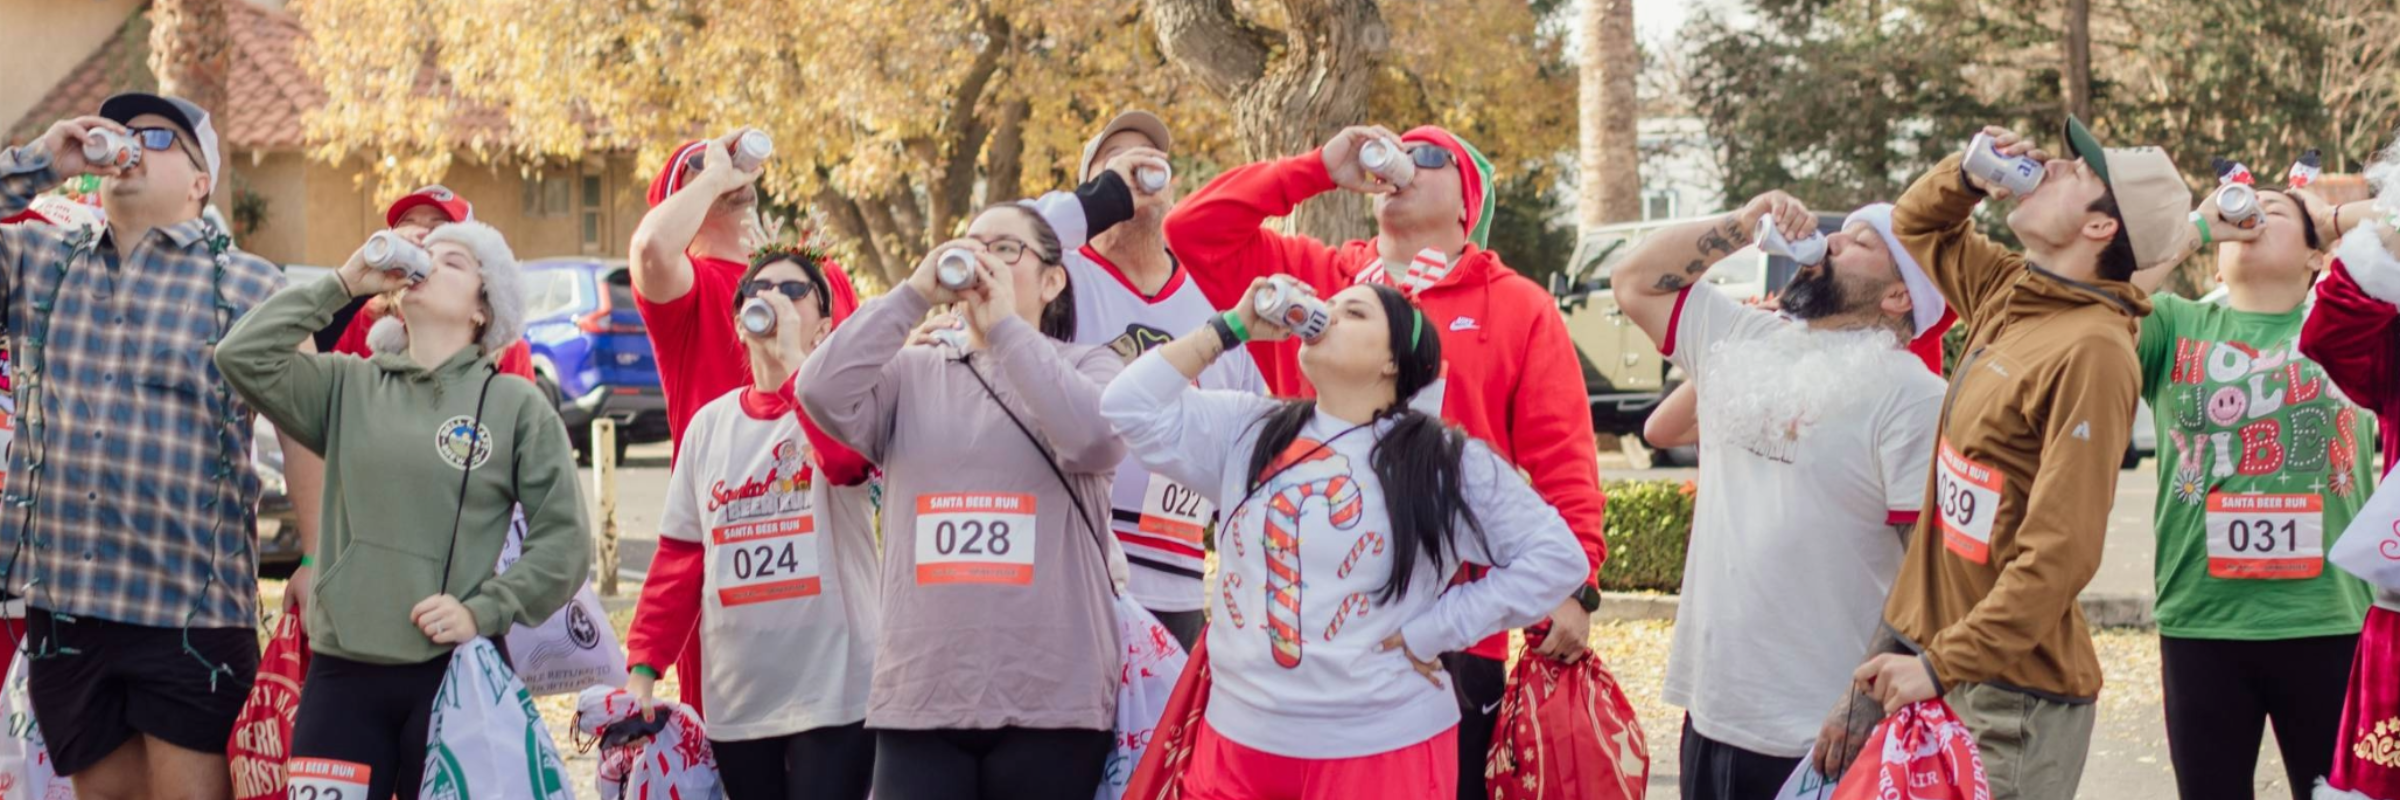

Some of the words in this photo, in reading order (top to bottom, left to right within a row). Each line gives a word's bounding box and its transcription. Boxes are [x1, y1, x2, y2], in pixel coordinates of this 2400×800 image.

[2169, 402, 2357, 477] VIBES
[1968, 466, 1990, 483] RUN
[726, 493, 776, 522] BEER
[930, 497, 963, 510] SANTA
[965, 496, 992, 509] BEER
[994, 496, 1019, 509] RUN
[1161, 483, 1202, 518] 022
[1940, 471, 1976, 526] 039
[2221, 496, 2254, 509] SANTA
[2256, 496, 2282, 509] BEER
[2285, 496, 2308, 509] RUN
[724, 525, 755, 540] SANTA
[755, 522, 778, 535] BEER
[780, 519, 800, 532] RUN
[935, 519, 1010, 556] 028
[2228, 518, 2296, 552] 031
[733, 541, 798, 580] 024
[305, 761, 330, 775] BEER
[331, 763, 355, 779] RUN
